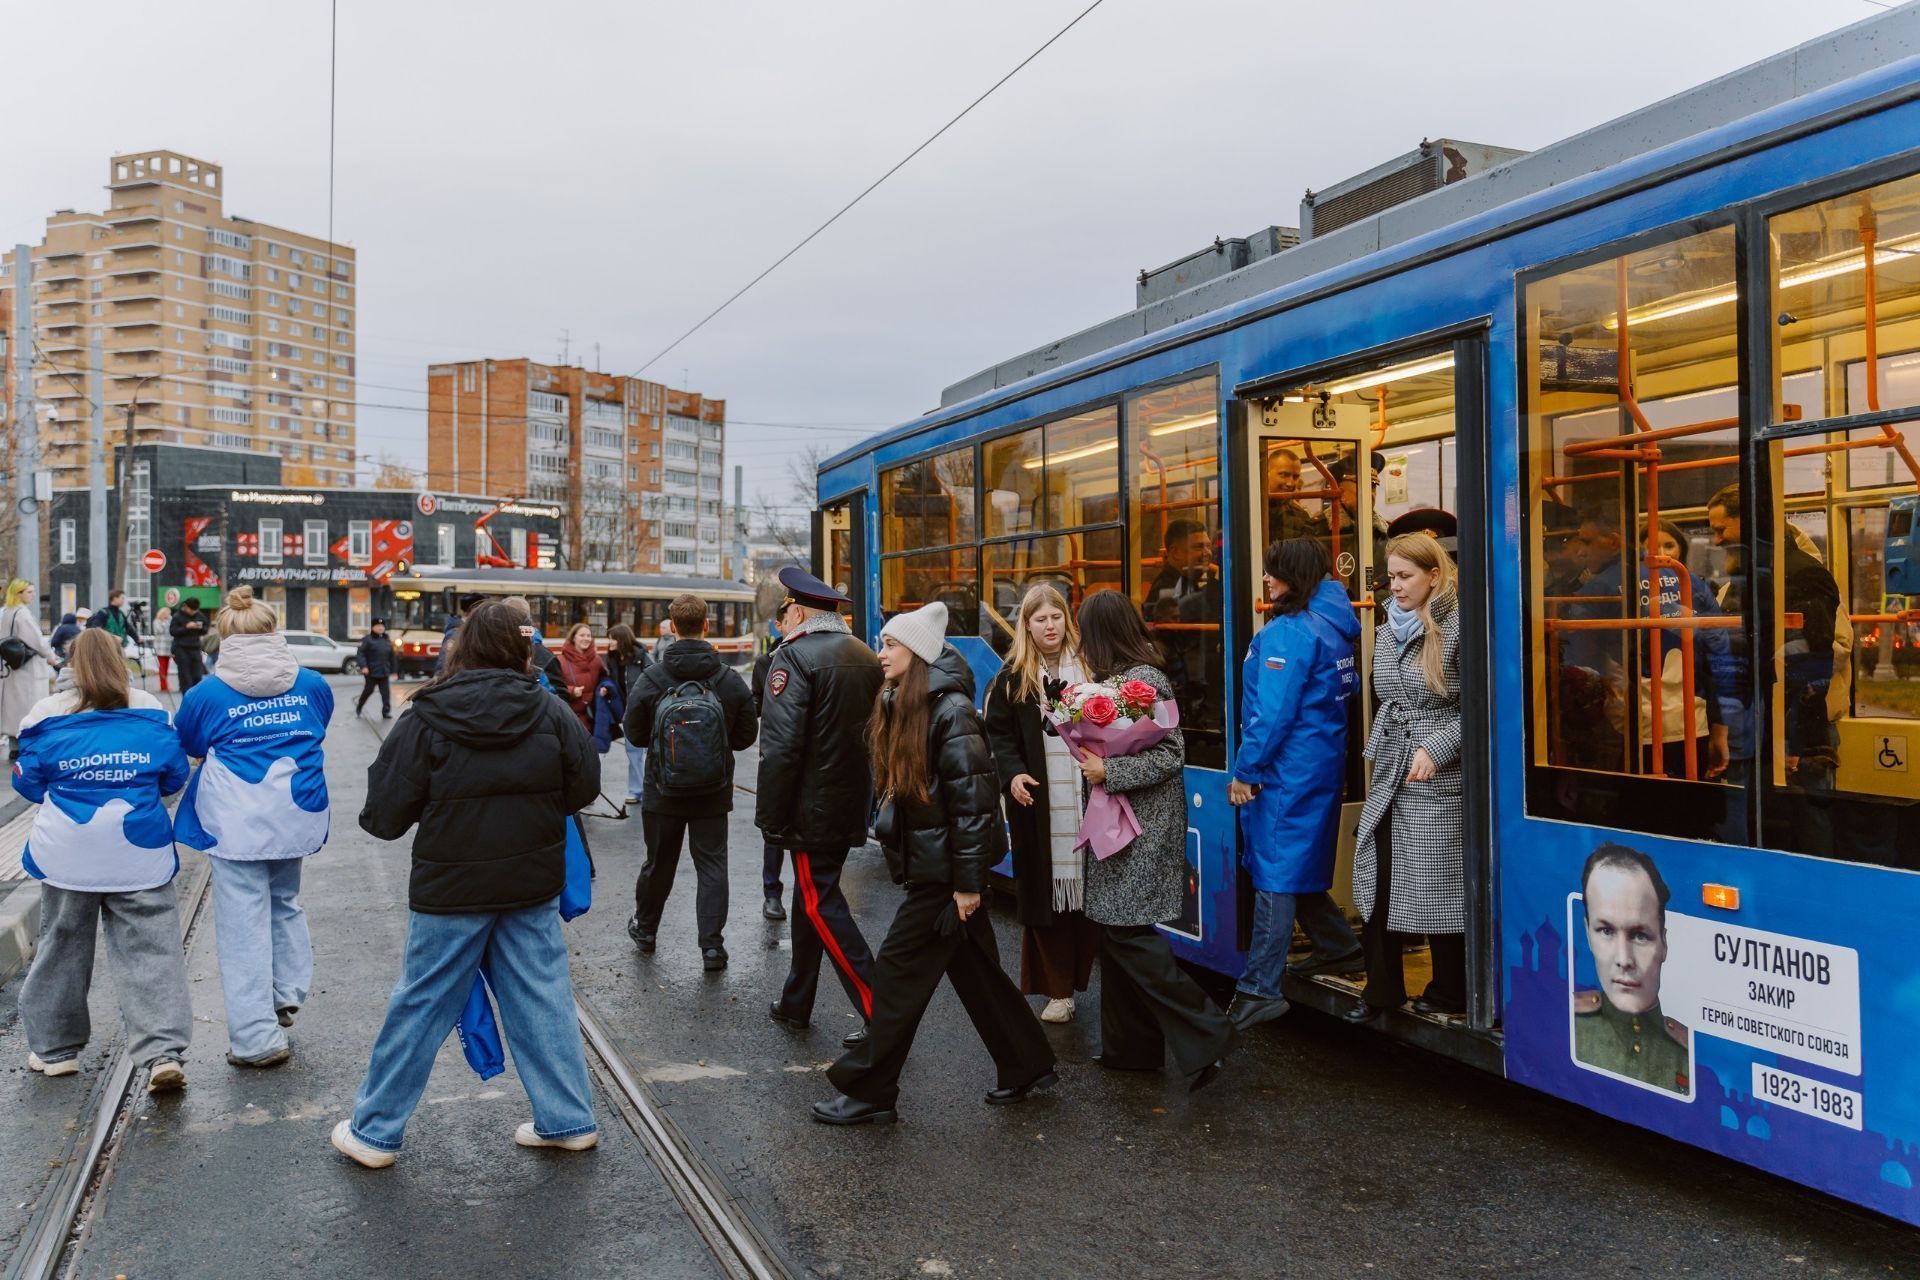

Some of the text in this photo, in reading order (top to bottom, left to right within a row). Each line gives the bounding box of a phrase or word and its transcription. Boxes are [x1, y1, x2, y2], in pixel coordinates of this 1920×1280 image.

[238, 568, 331, 580] АВТОЗАПЧАСТИ
[228, 694, 308, 719] ВОЛОНТЁРЫ
[243, 711, 301, 728] ПОБЕДЫ
[58, 750, 151, 771] ВОЛОНТЁРЫ
[1714, 933, 1831, 985] СУЛТАНОВ
[1748, 981, 1795, 1009] ЗАКИР
[1702, 1007, 1849, 1059] ГЕРОЙ СОВЕТСКОГО СОЮЗА
[1761, 1071, 1854, 1120] 1923-1983
